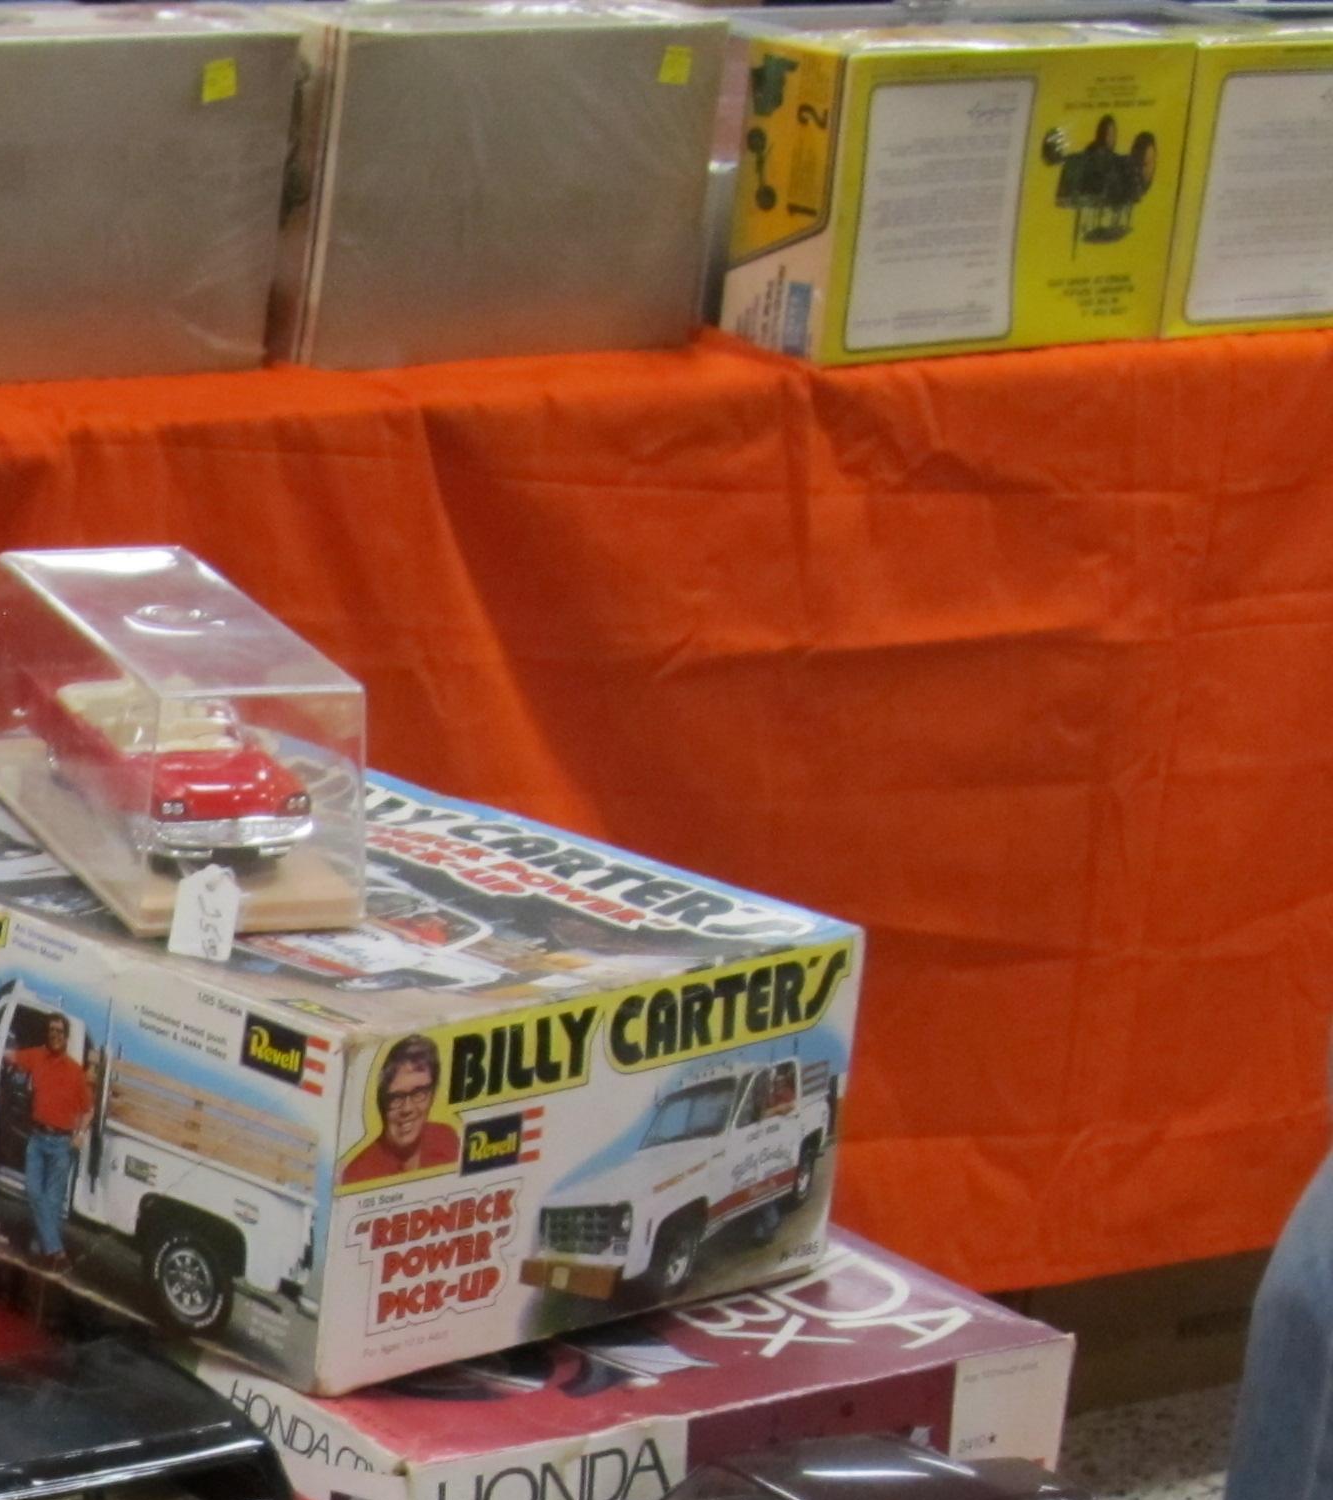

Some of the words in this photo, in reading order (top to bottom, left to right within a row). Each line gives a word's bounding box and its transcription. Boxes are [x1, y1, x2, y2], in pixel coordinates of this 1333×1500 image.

[796, 103, 829, 129] 2
[249, 1024, 302, 1074] Revell
[448, 1005, 600, 1105] BILLY
[609, 949, 849, 1066] CARTER'S
[467, 1129, 519, 1162] Revell
[376, 1266, 501, 1325] PICK-UP
[674, 1293, 857, 1359] BX
[228, 1378, 331, 1459] HONDA
